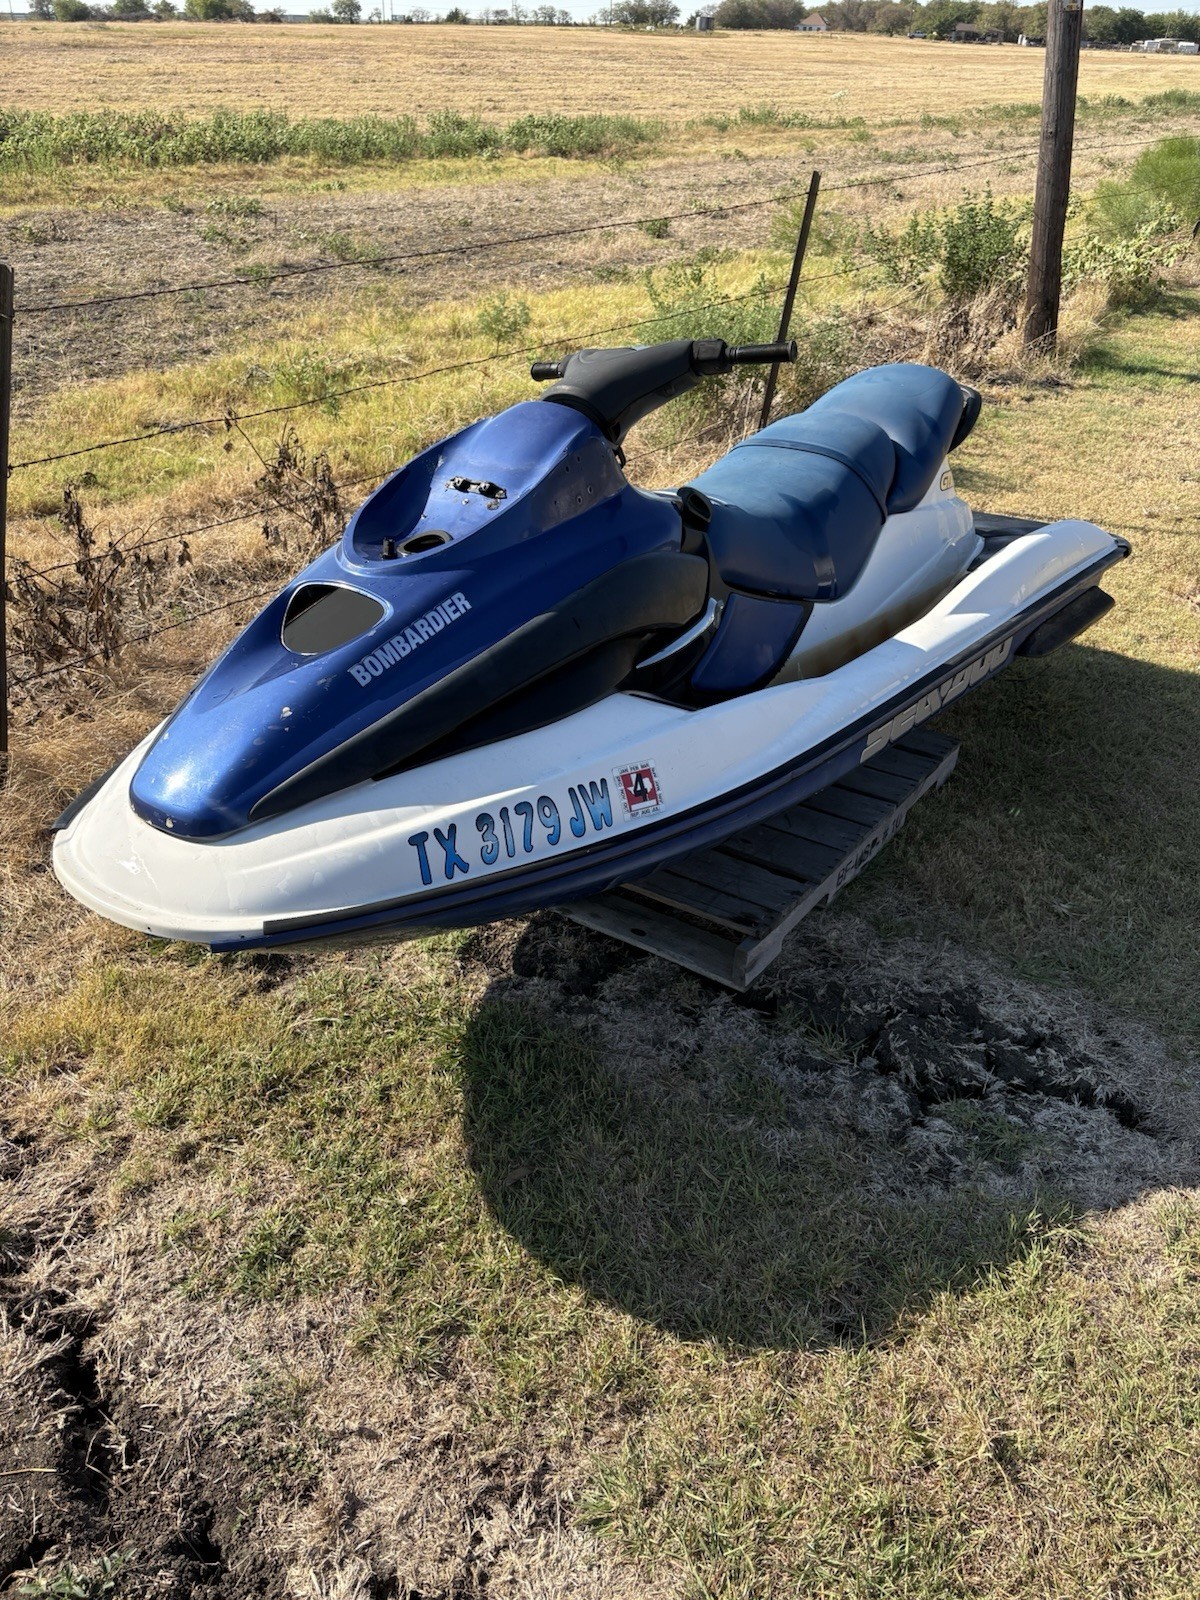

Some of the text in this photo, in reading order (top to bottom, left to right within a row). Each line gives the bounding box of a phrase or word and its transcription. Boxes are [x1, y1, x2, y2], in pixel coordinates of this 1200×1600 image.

[347, 592, 472, 687] BOMBARDIER
[408, 778, 614, 885] TX 3179 JW
[633, 773, 648, 802] 4
